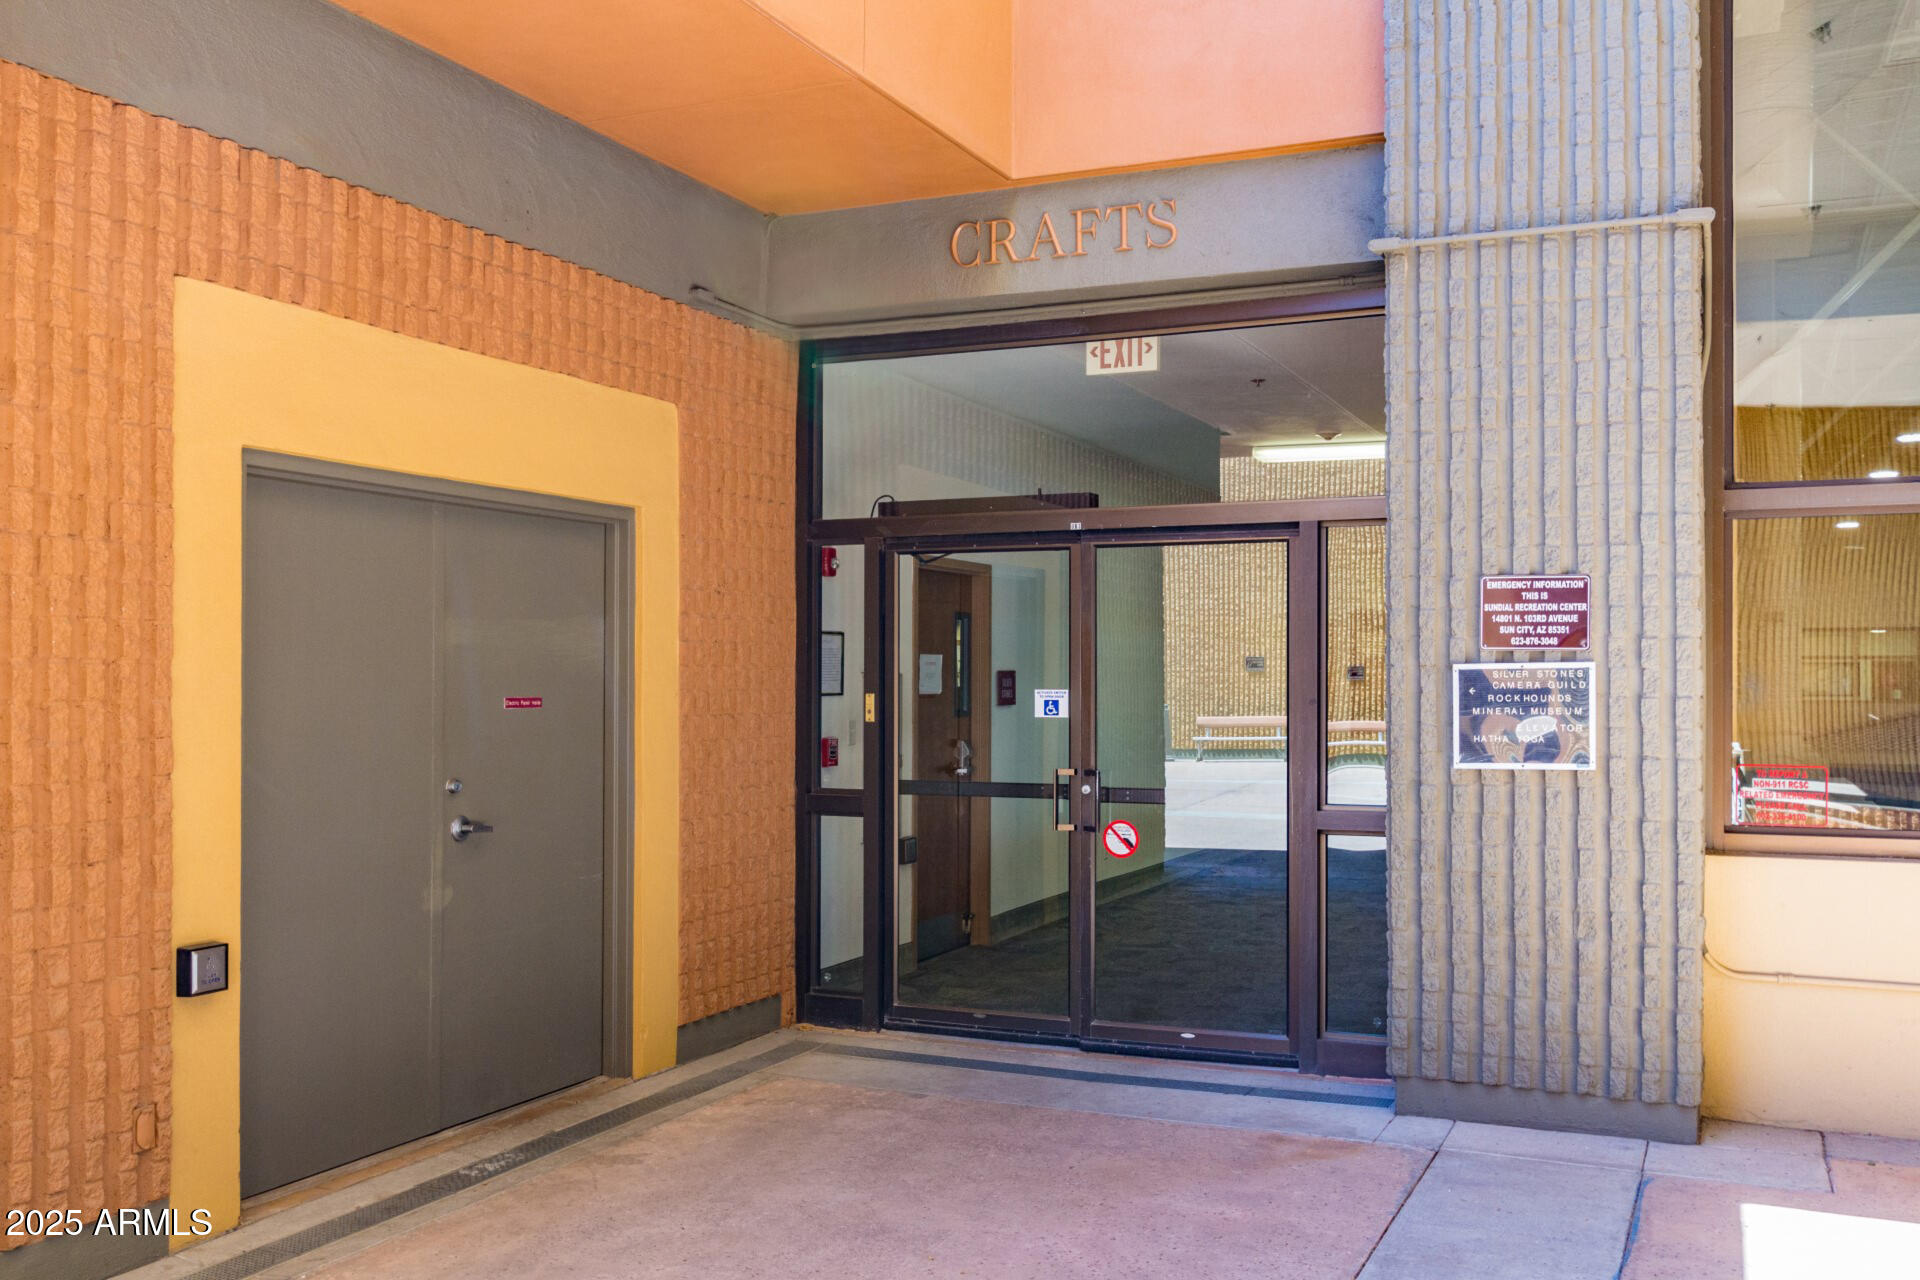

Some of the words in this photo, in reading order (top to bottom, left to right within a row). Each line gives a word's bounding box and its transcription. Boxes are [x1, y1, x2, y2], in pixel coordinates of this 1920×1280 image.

[950, 199, 1178, 268] CRAFTS
[1487, 580, 1531, 589] EMERGENCY
[1533, 580, 1584, 588] INFORMATION
[1521, 592, 1539, 600] THIS
[1540, 592, 1548, 600] IS
[1484, 603, 1513, 611] SUNDIAL
[1515, 603, 1558, 611] RECREATION
[1559, 603, 1587, 611] CENTER
[1492, 614, 1513, 622] 14801
[1514, 614, 1522, 622] N.
[1524, 614, 1547, 622] 103RD
[1548, 614, 1579, 622] AVENUE
[1499, 626, 1515, 634] SUN
[1516, 626, 1535, 635] CITY,
[1548, 625, 1569, 633] 85351
[1492, 669, 1529, 679] SILVER
[1537, 669, 1584, 678] STONES
[1492, 681, 1541, 690] CAMERA
[1547, 680, 1586, 689] GUILD
[1472, 707, 1526, 716] MINERAL
[1530, 707, 1583, 715] MUSEUM
[1473, 735, 1509, 743] HATHA
[1753, 780, 1786, 788] NON-911
[1788, 780, 1809, 789] RCSC
[1740, 789, 1774, 799] RELATED
